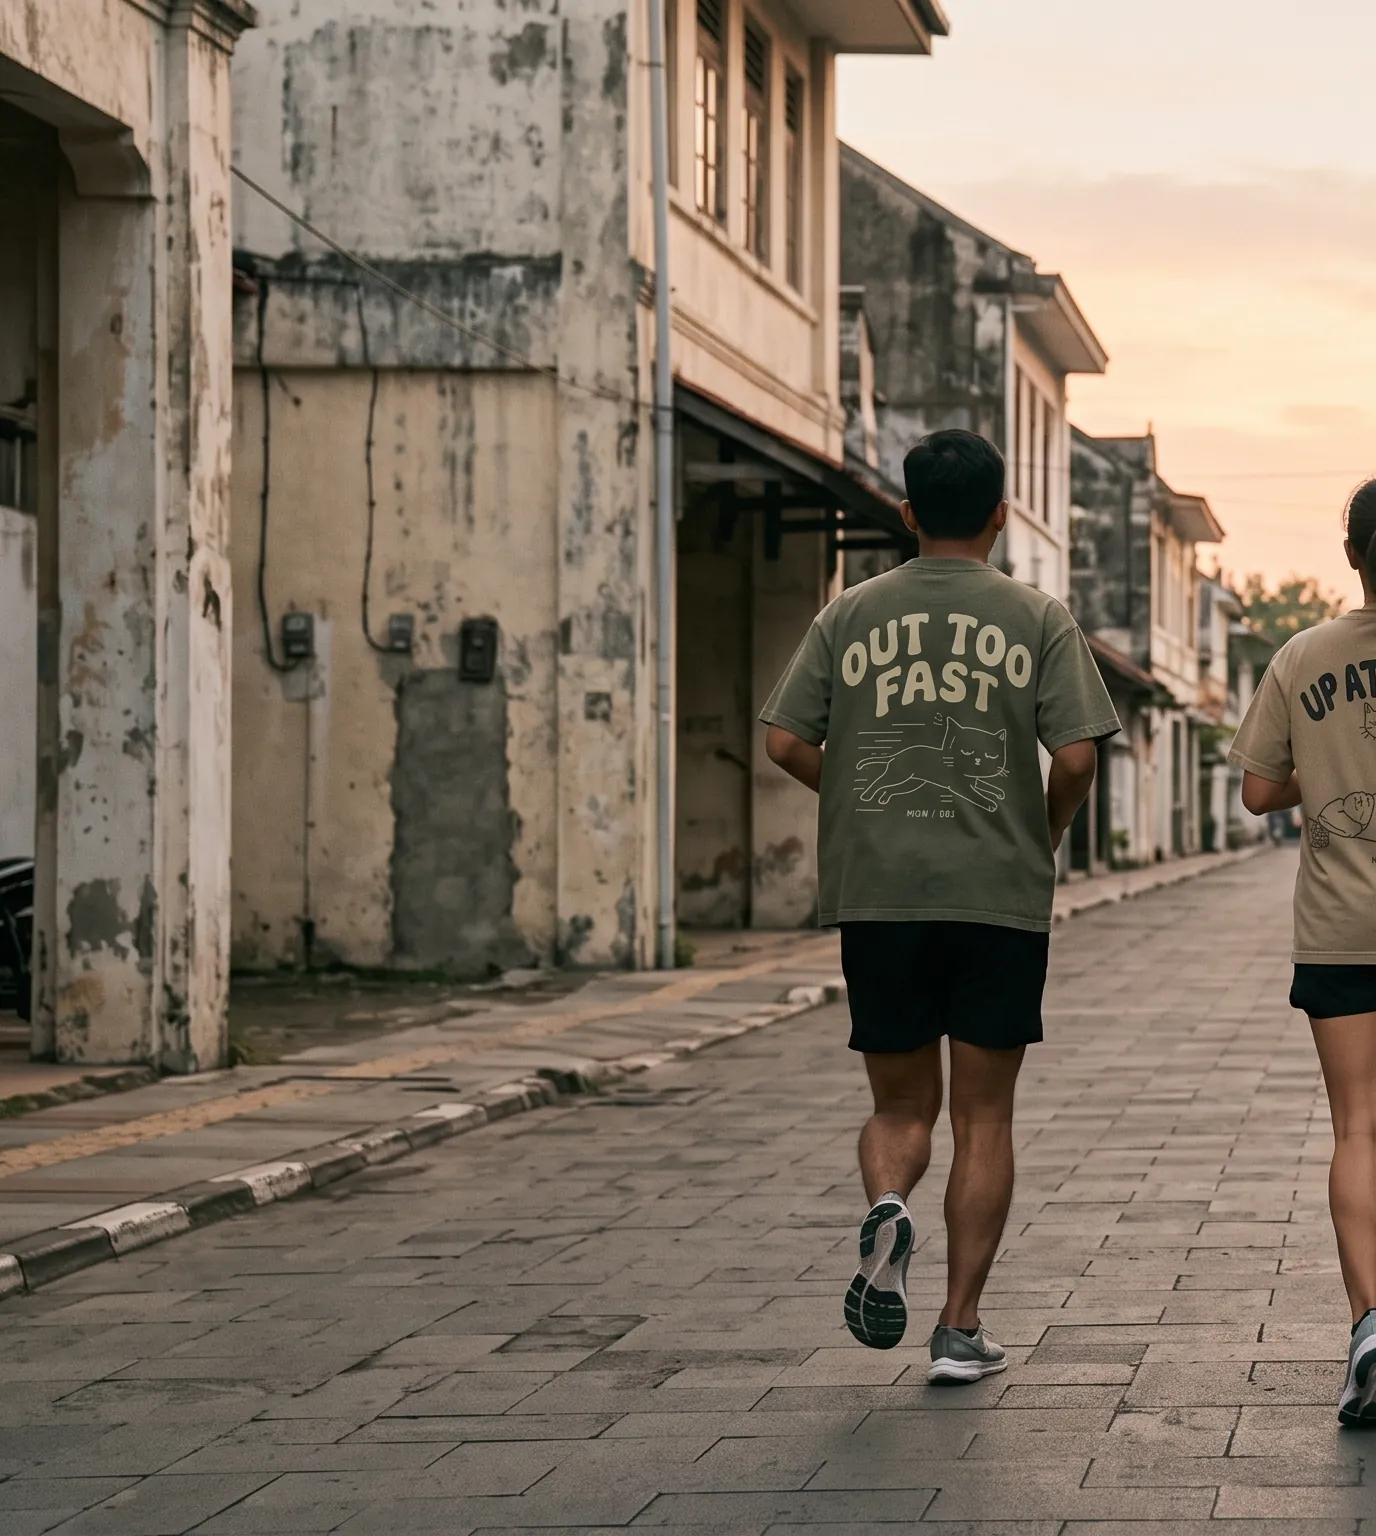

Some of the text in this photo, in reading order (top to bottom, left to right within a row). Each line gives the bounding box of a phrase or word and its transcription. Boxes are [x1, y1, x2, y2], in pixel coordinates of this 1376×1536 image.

[842, 613, 1032, 688] OUT TOO
[875, 660, 998, 718] FAST
[1300, 672, 1337, 721] UP
